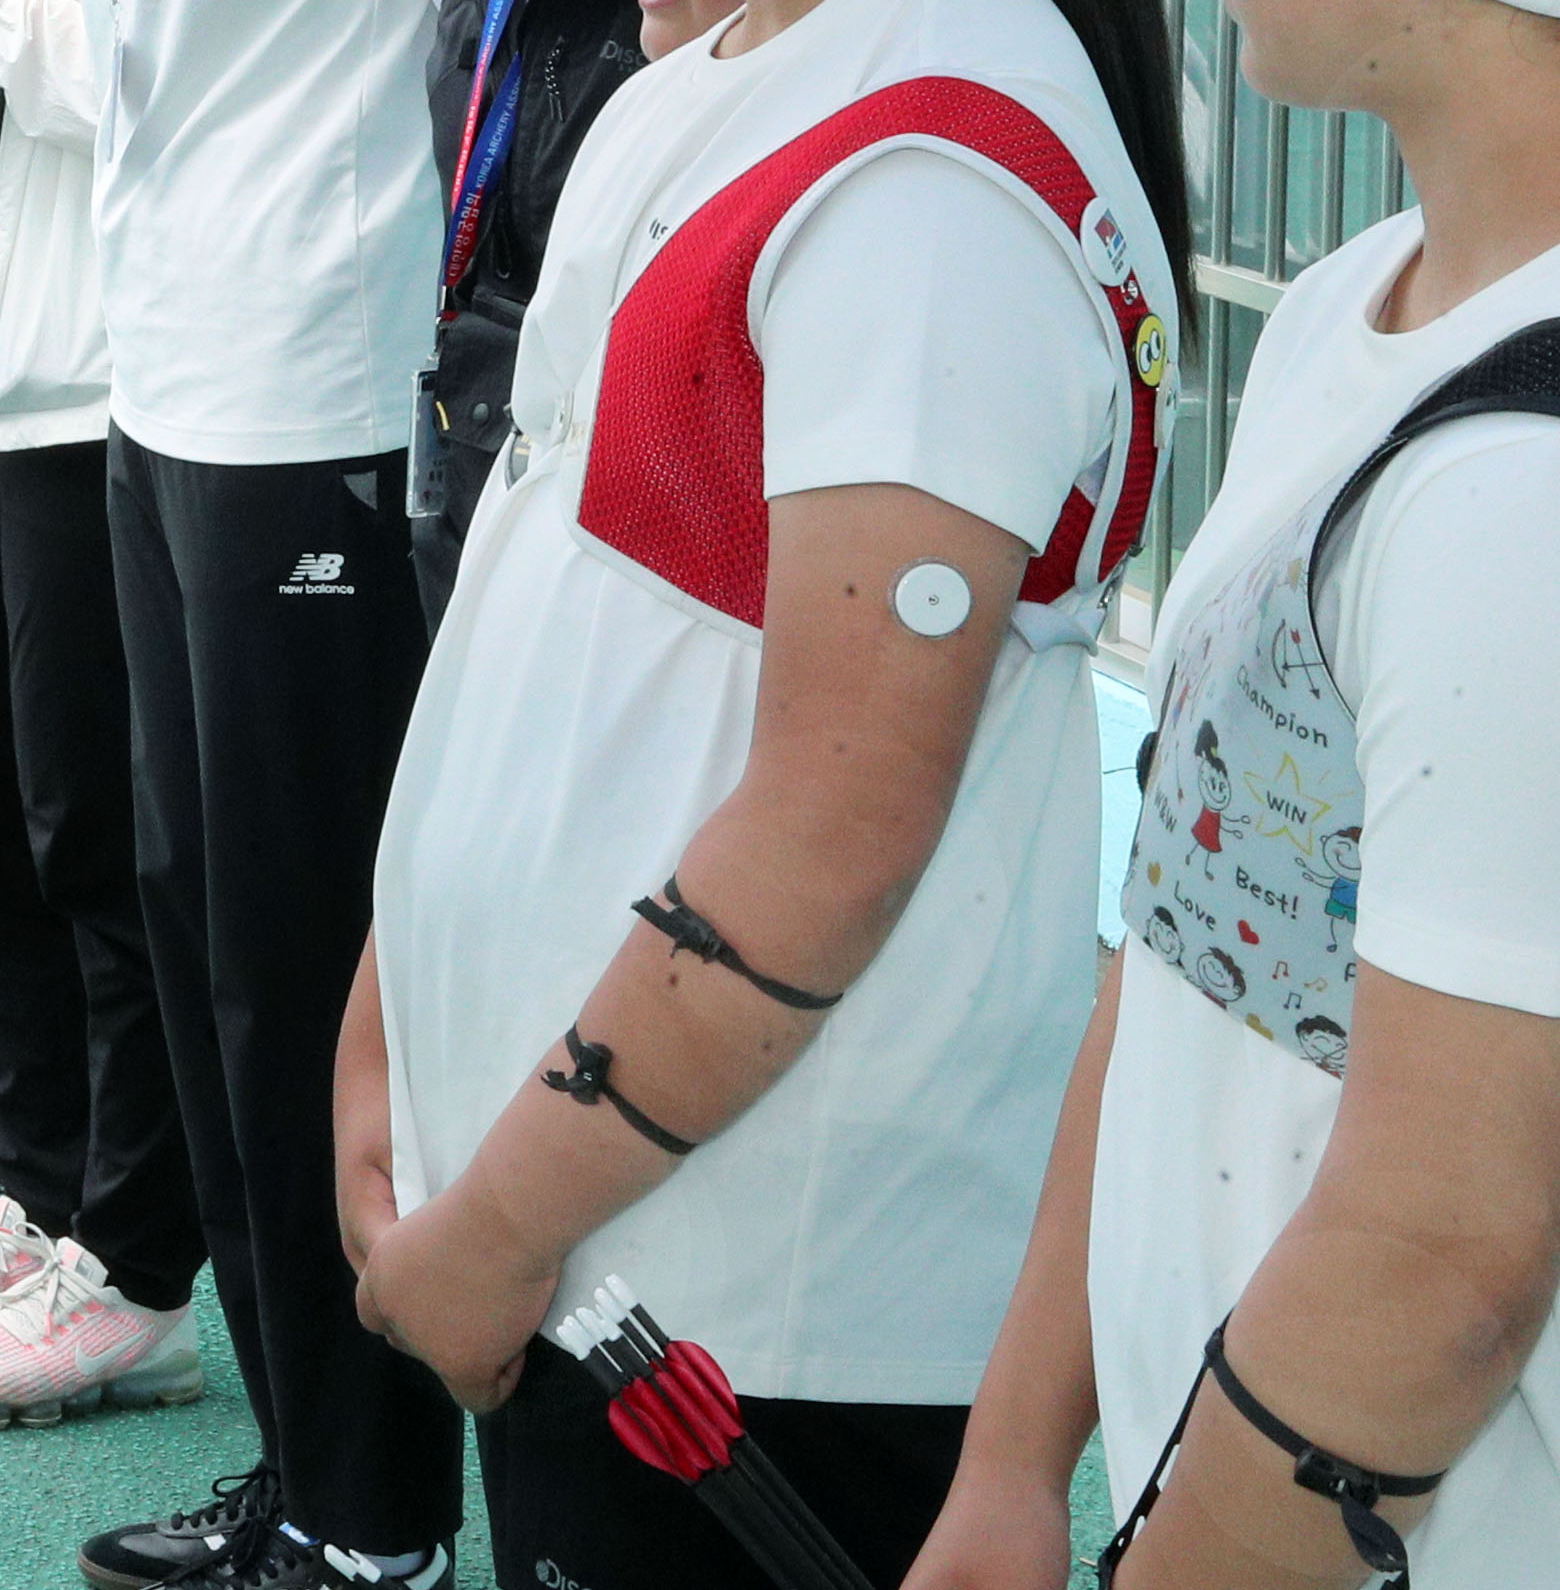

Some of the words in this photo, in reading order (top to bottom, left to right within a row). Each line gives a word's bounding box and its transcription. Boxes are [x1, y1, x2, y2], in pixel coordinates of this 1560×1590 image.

[475, 158, 495, 189] KOREA
[489, 110, 511, 156] ARCHERY
[279, 584, 304, 595] new
[305, 582, 355, 595] balance
[1236, 664, 1329, 749] Champion
[1266, 790, 1307, 825] WIN
[1175, 880, 1218, 931] Love
[1236, 866, 1300, 921] Best!
